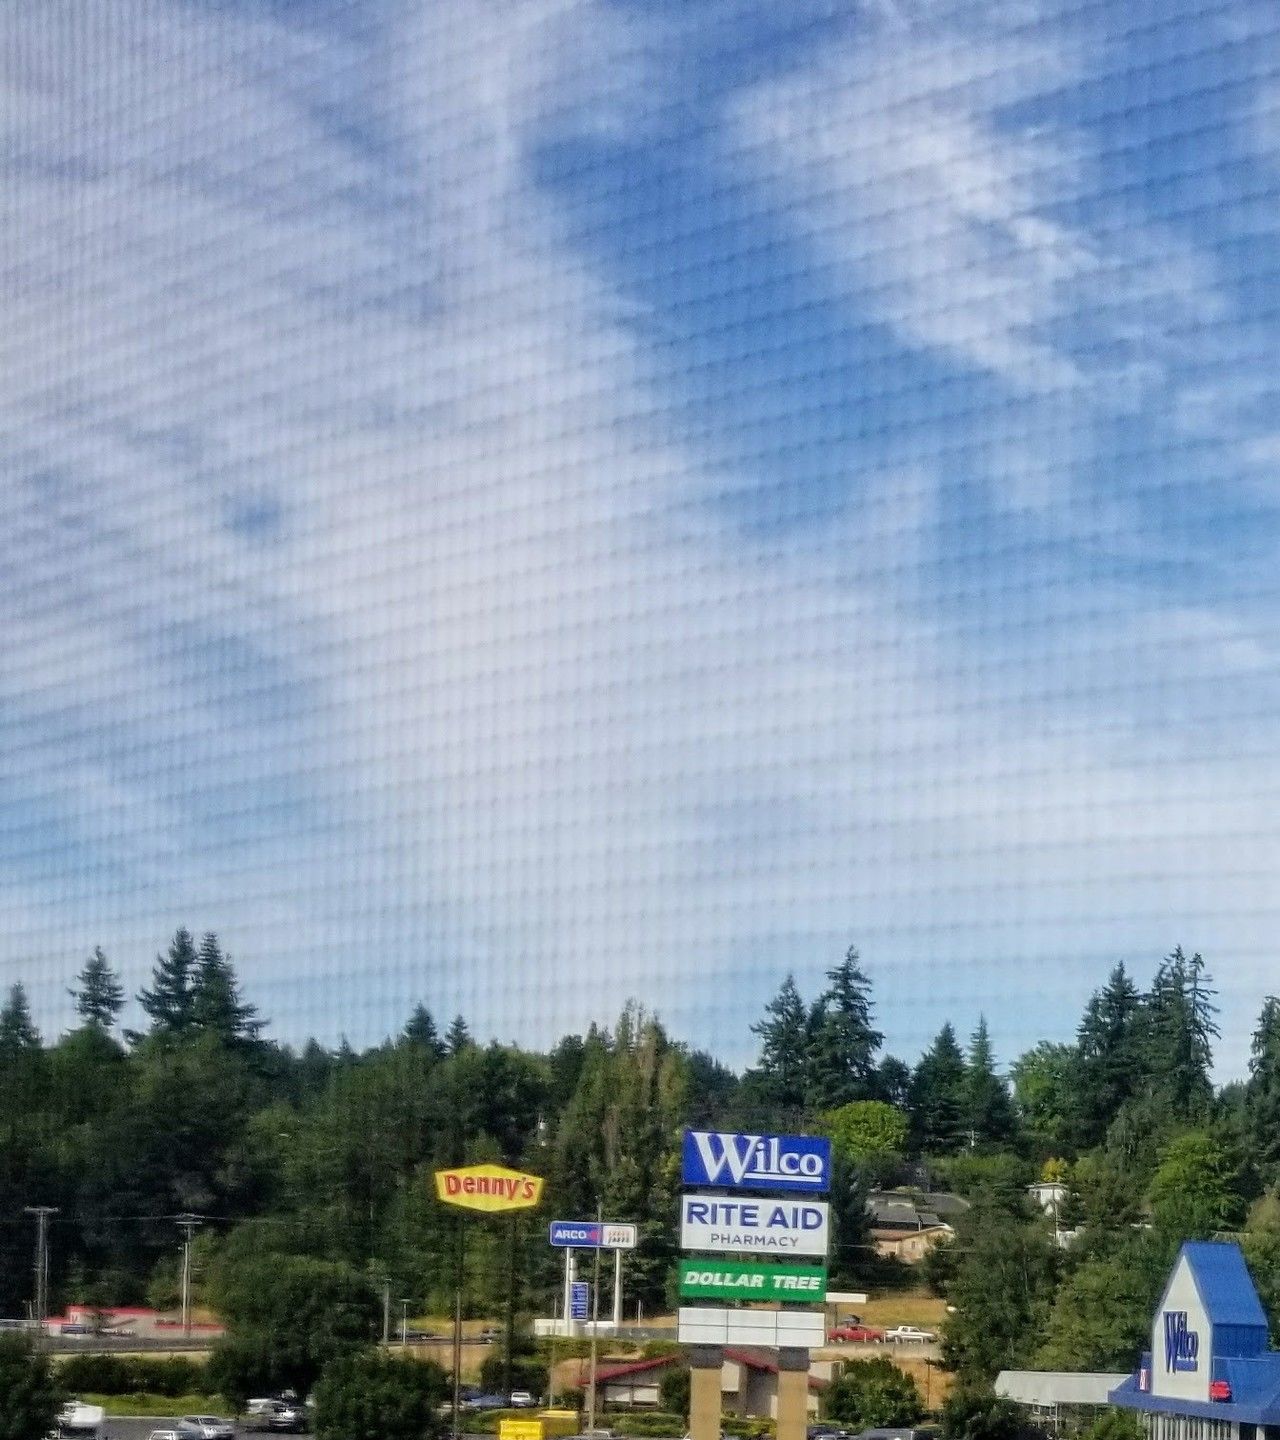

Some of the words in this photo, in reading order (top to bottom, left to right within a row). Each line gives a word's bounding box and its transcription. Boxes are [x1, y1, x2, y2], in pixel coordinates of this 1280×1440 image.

[691, 1132, 823, 1184] Wilco
[444, 1174, 535, 1200] Denny's
[686, 1202, 760, 1227] RITE
[766, 1206, 823, 1230] AID
[554, 1230, 587, 1239] ARCO
[710, 1233, 799, 1247] PHARMACY
[684, 1271, 764, 1288] DOLLAR
[773, 1275, 822, 1290] TREE
